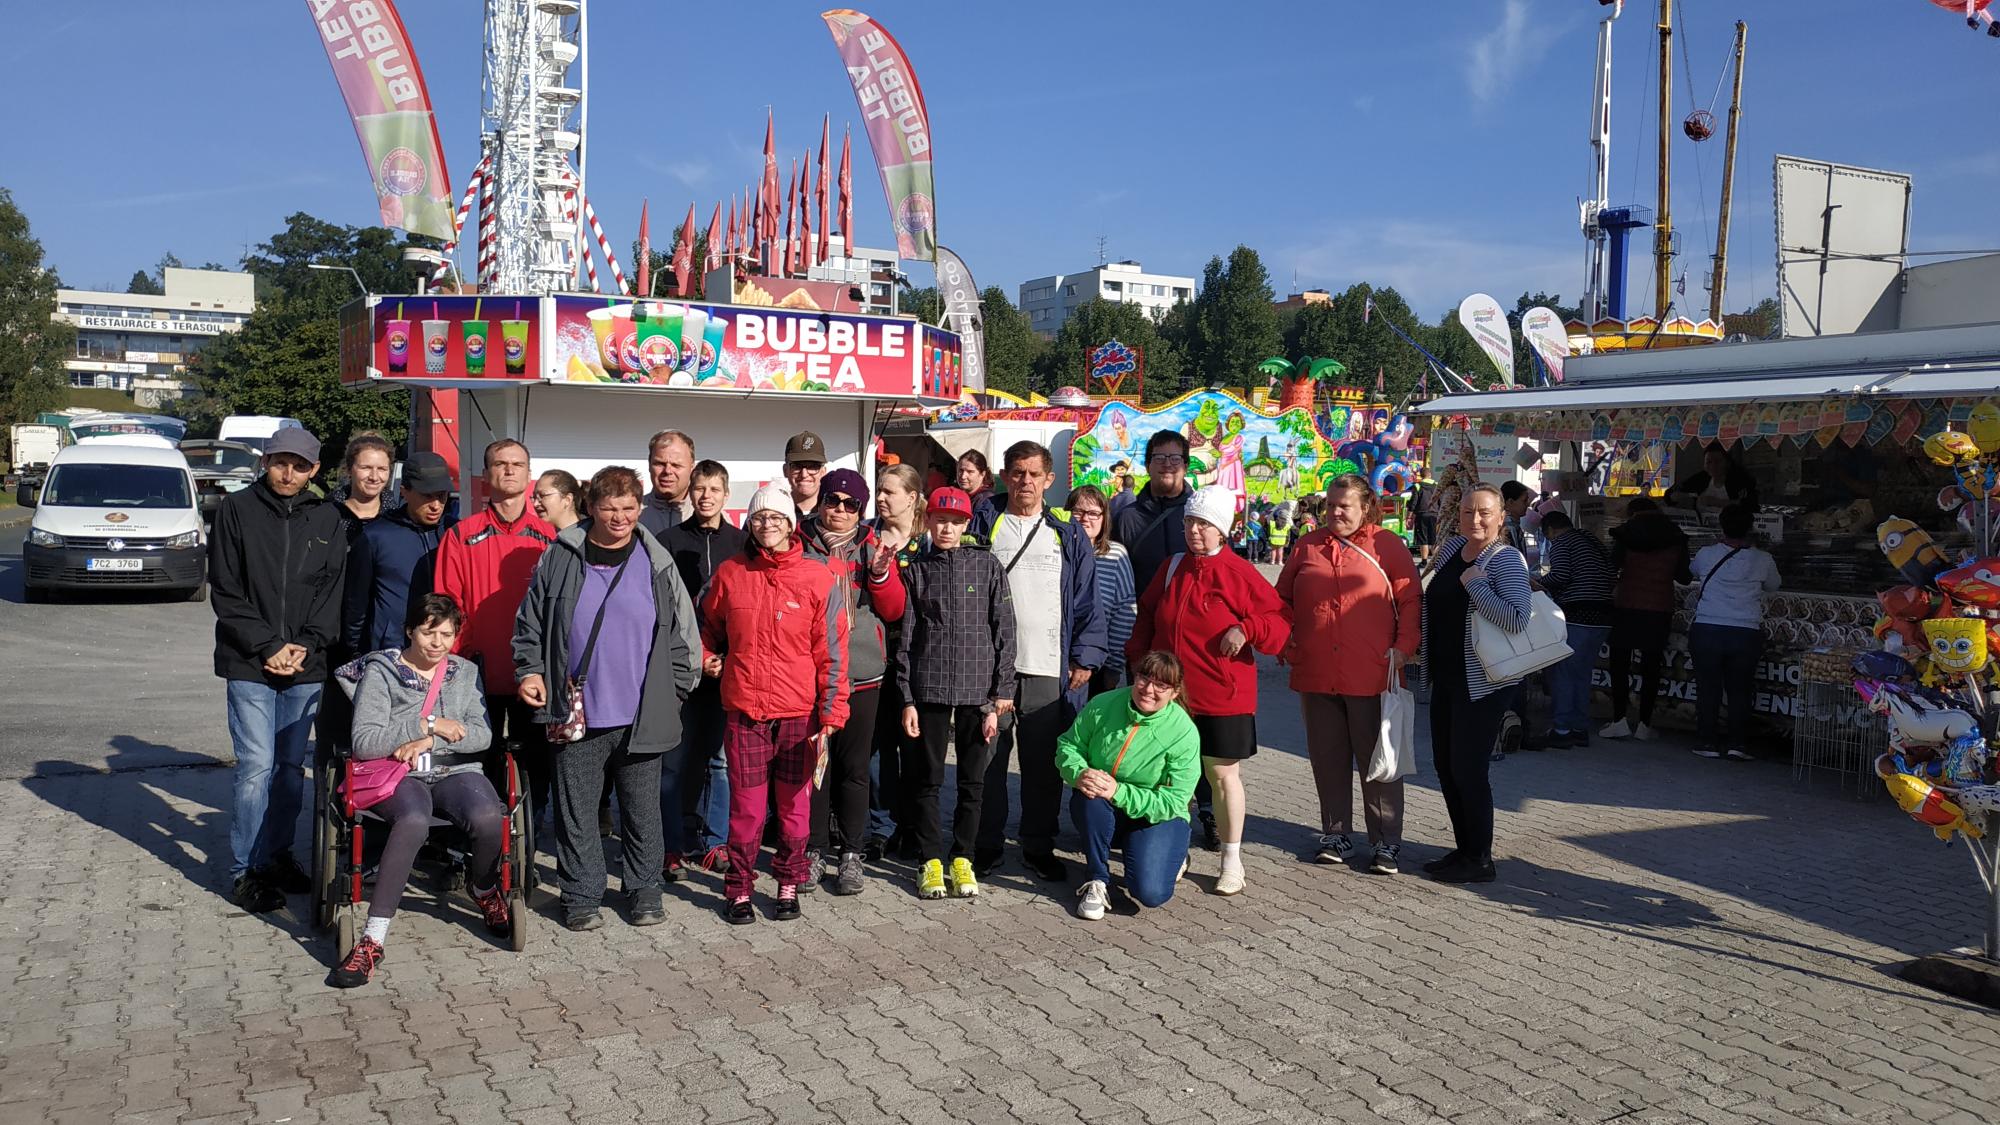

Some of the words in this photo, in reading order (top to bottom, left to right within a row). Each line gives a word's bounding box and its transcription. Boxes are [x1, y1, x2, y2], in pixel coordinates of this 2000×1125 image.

[86, 317, 157, 329] RESTAURACE
[161, 321, 168, 330] S
[173, 322, 221, 332] TERASOU
[736, 313, 905, 358] BUBBLE
[778, 352, 865, 389] TEA
[94, 559, 111, 568] 7C2
[117, 559, 139, 568] 3760
